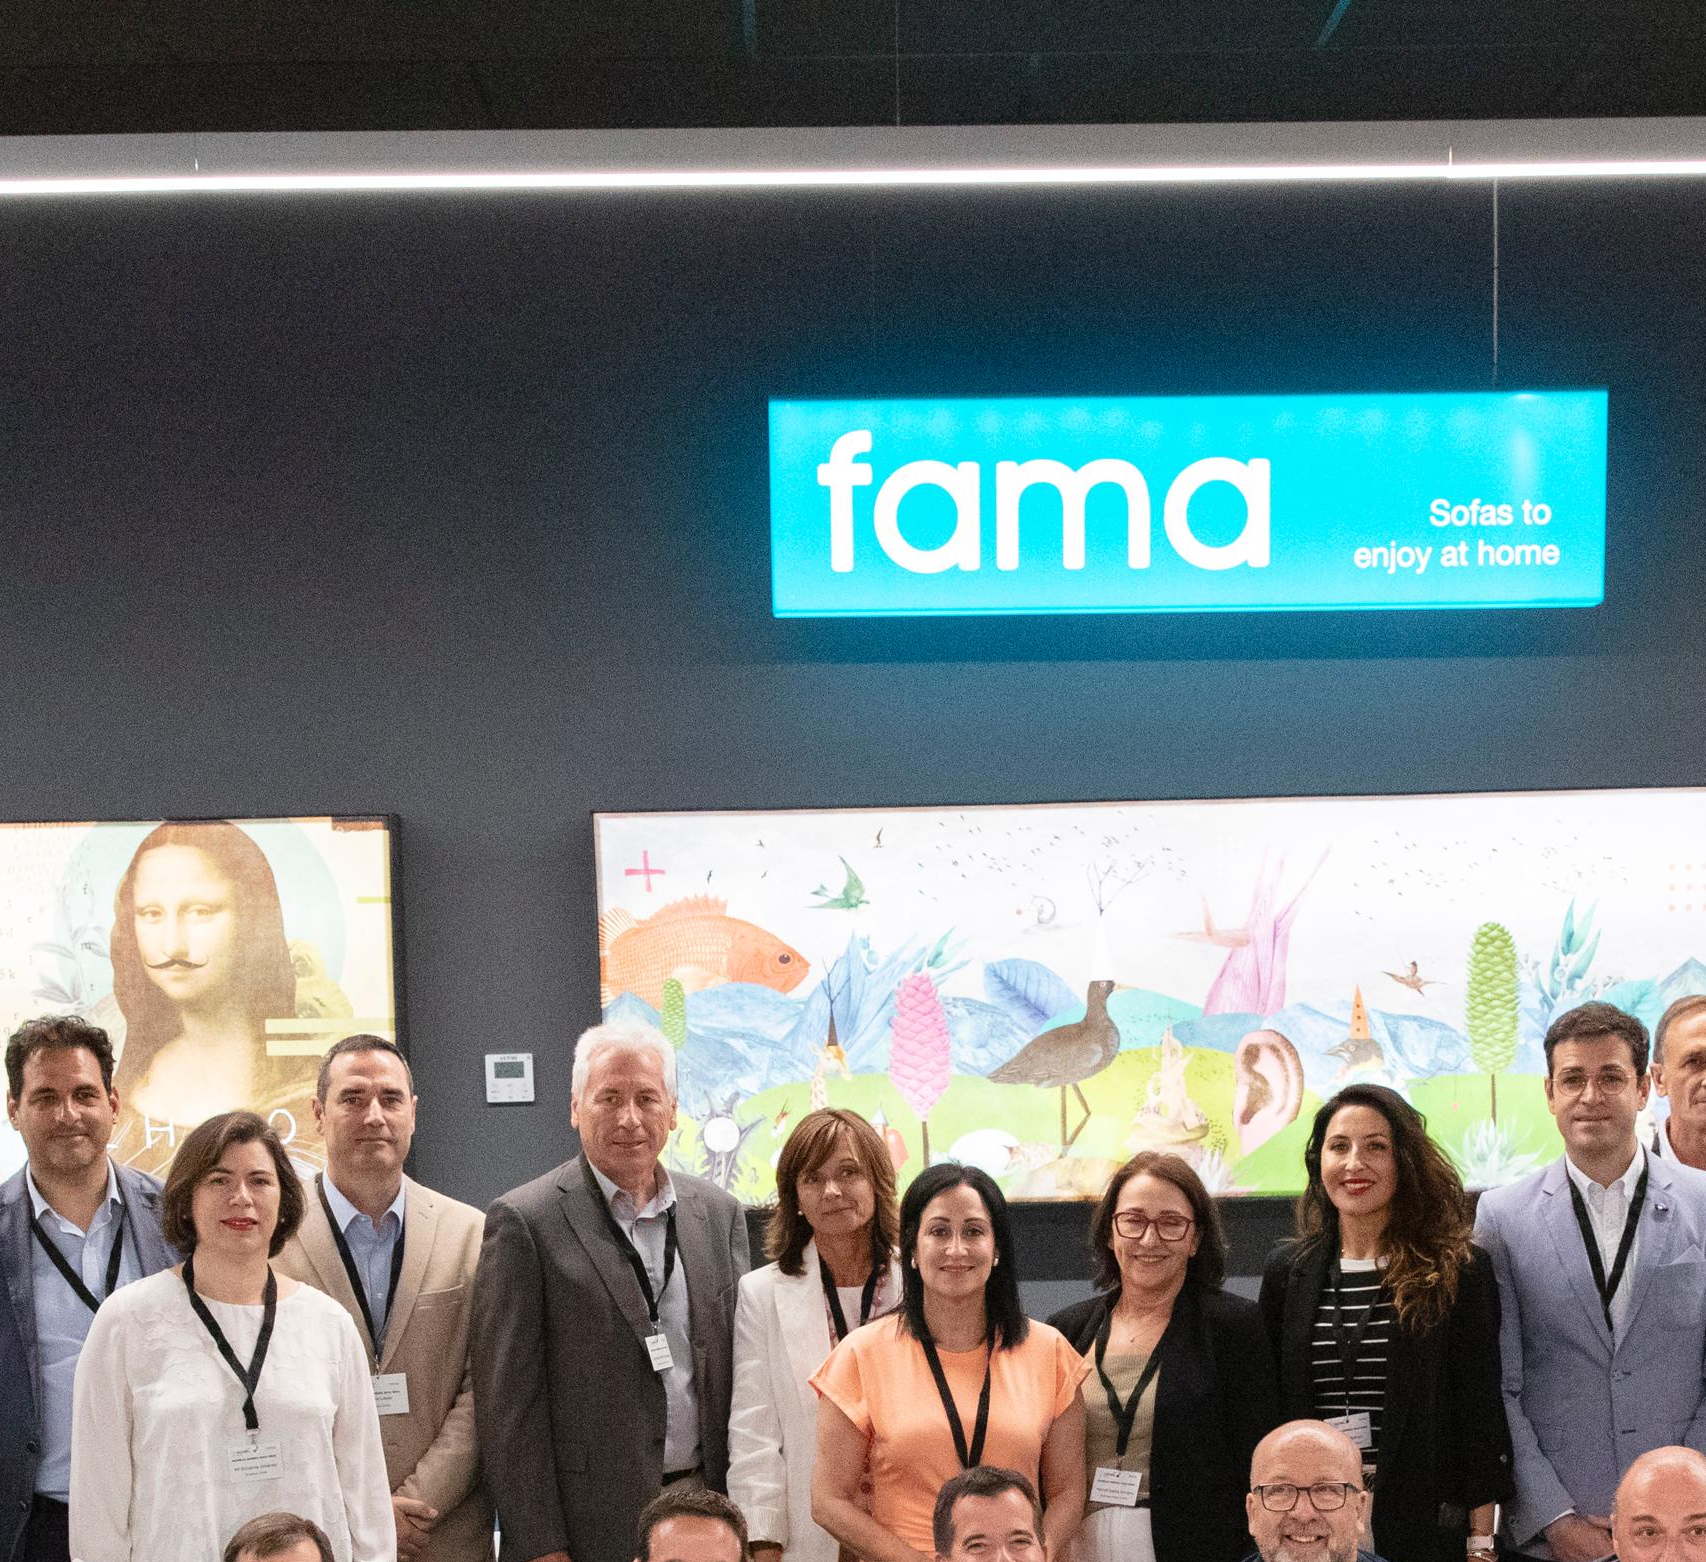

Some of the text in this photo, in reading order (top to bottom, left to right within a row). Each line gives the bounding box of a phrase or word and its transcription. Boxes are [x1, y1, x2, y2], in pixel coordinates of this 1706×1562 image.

[817, 430, 1272, 574] fama
[1429, 499, 1553, 529] Sofas to
[1353, 538, 1561, 576] enjoy at home
